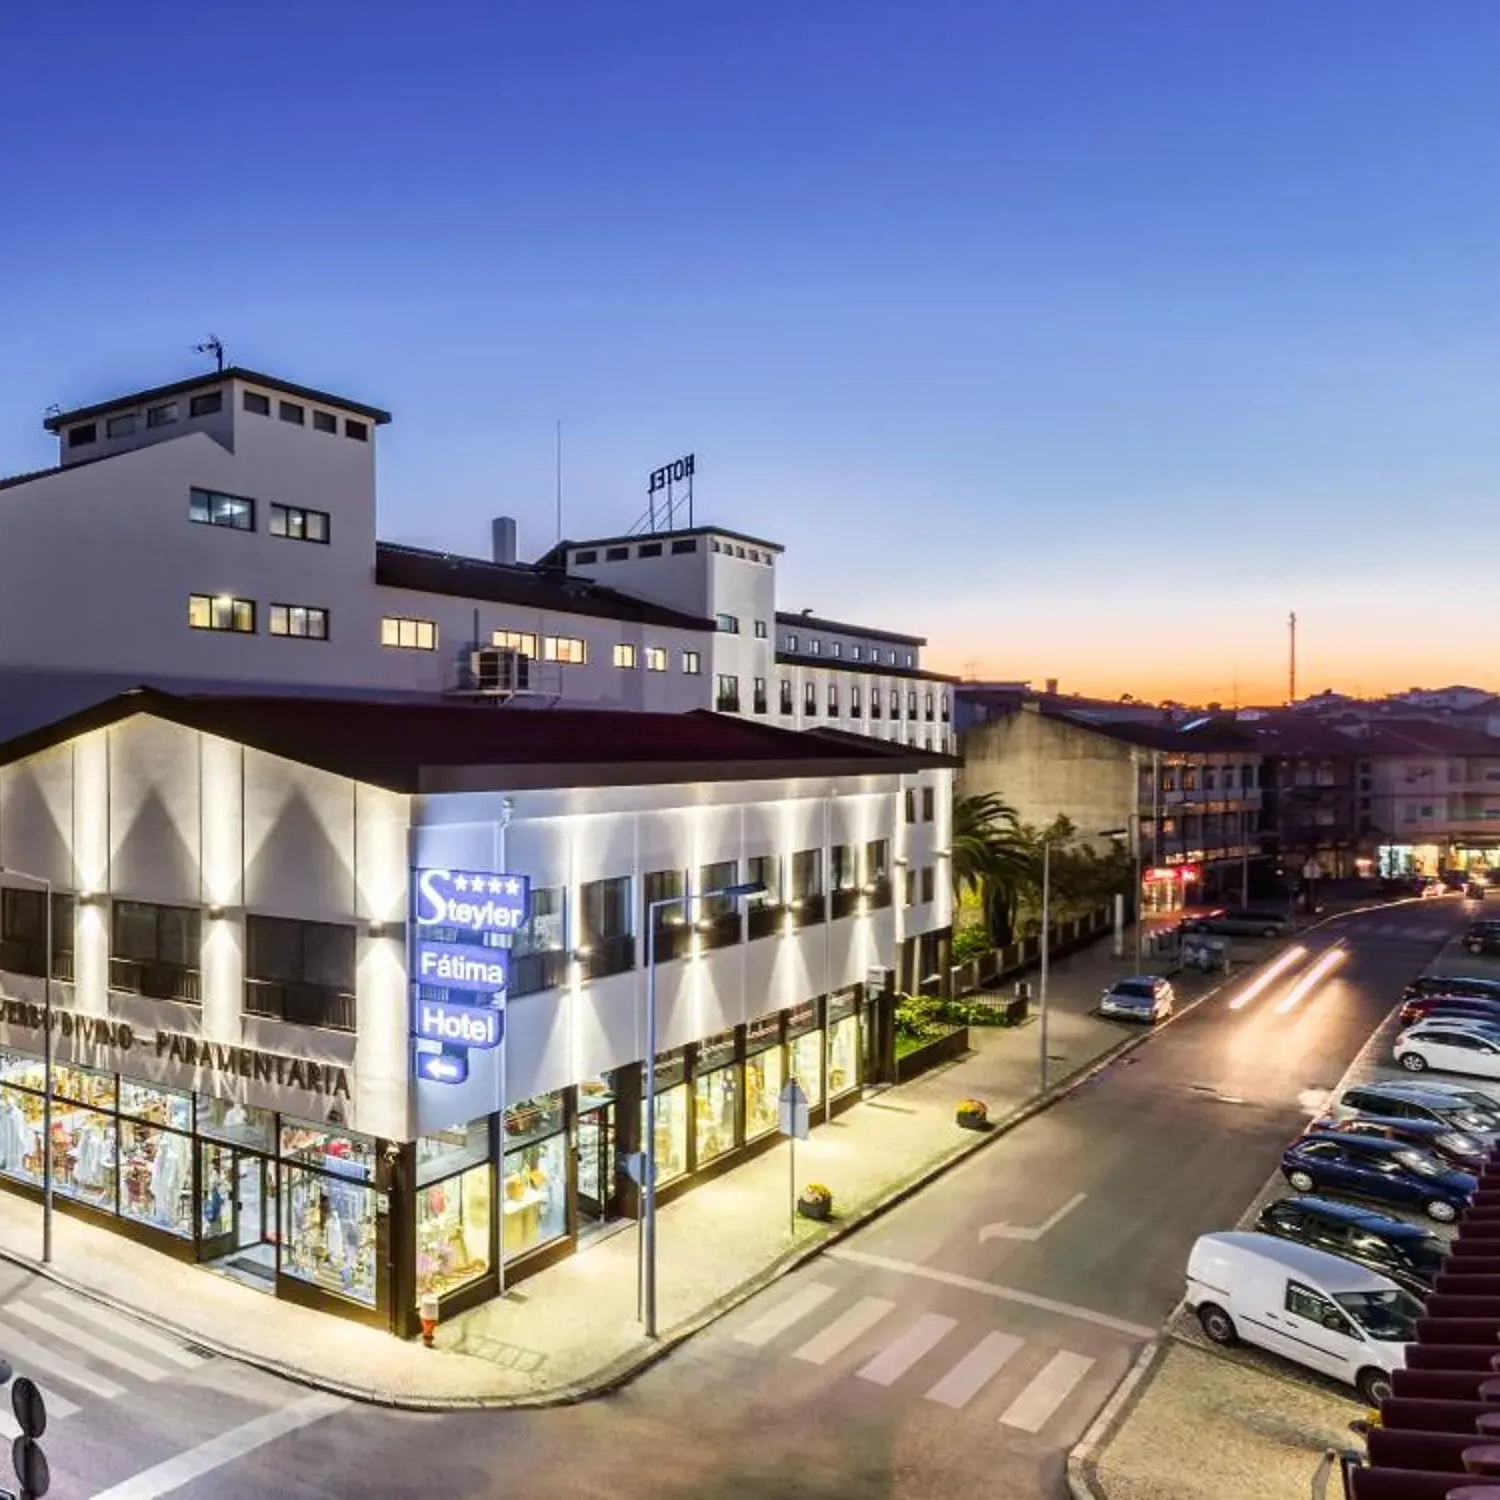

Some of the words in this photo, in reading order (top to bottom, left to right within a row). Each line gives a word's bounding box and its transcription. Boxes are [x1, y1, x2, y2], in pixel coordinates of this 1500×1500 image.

[417, 868, 521, 930] Steyler
[420, 951, 504, 984] Fátima
[422, 1006, 494, 1043] Hotel
[60, 1010, 132, 1050] DIVINO
[155, 1030, 351, 1100] PARAMENTARIA
